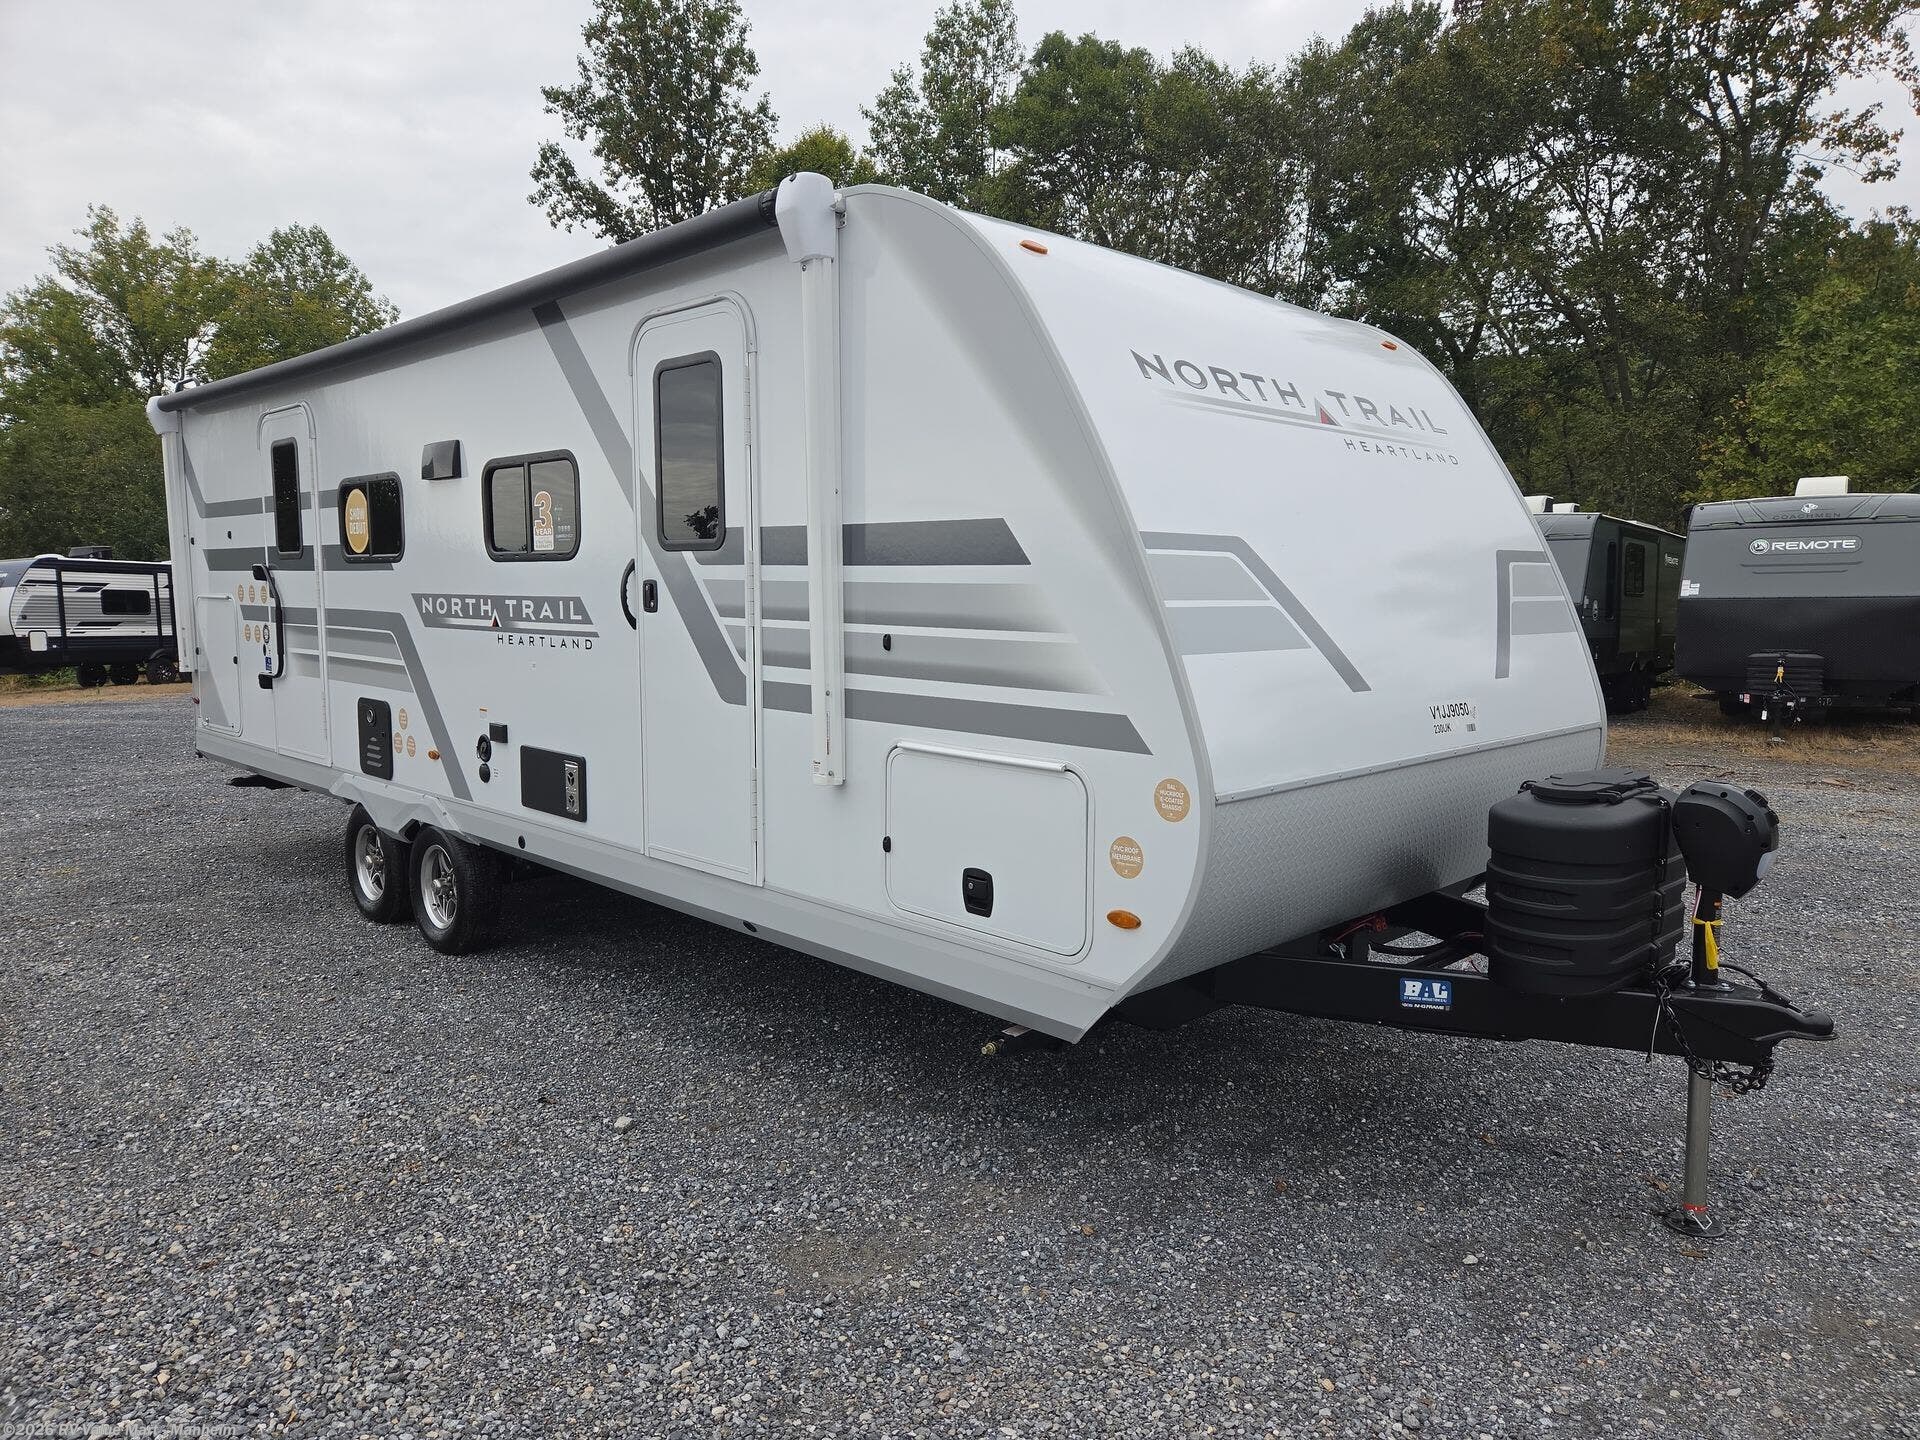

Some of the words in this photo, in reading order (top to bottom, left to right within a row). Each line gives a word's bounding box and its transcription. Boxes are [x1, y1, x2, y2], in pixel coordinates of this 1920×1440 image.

[1129, 348, 1307, 409] NORTH
[1323, 389, 1448, 435] TRAIL
[1343, 438, 1459, 466] HEARTLAND
[534, 491, 553, 528] 3
[1772, 512, 1841, 521] COACHMEN
[349, 521, 367, 535] DEBUT
[1771, 539, 1857, 551] REMOTE
[421, 597, 492, 617] NORTH
[504, 600, 582, 620] TRAIL
[497, 633, 593, 650] HEARTLAND
[1429, 702, 1470, 720] V1JJ9050
[1159, 790, 1185, 799] HUCKBOLT
[1113, 844, 1125, 852] PVC
[1124, 846, 1139, 854] ROOF
[1111, 852, 1142, 862] MEMBRANE
